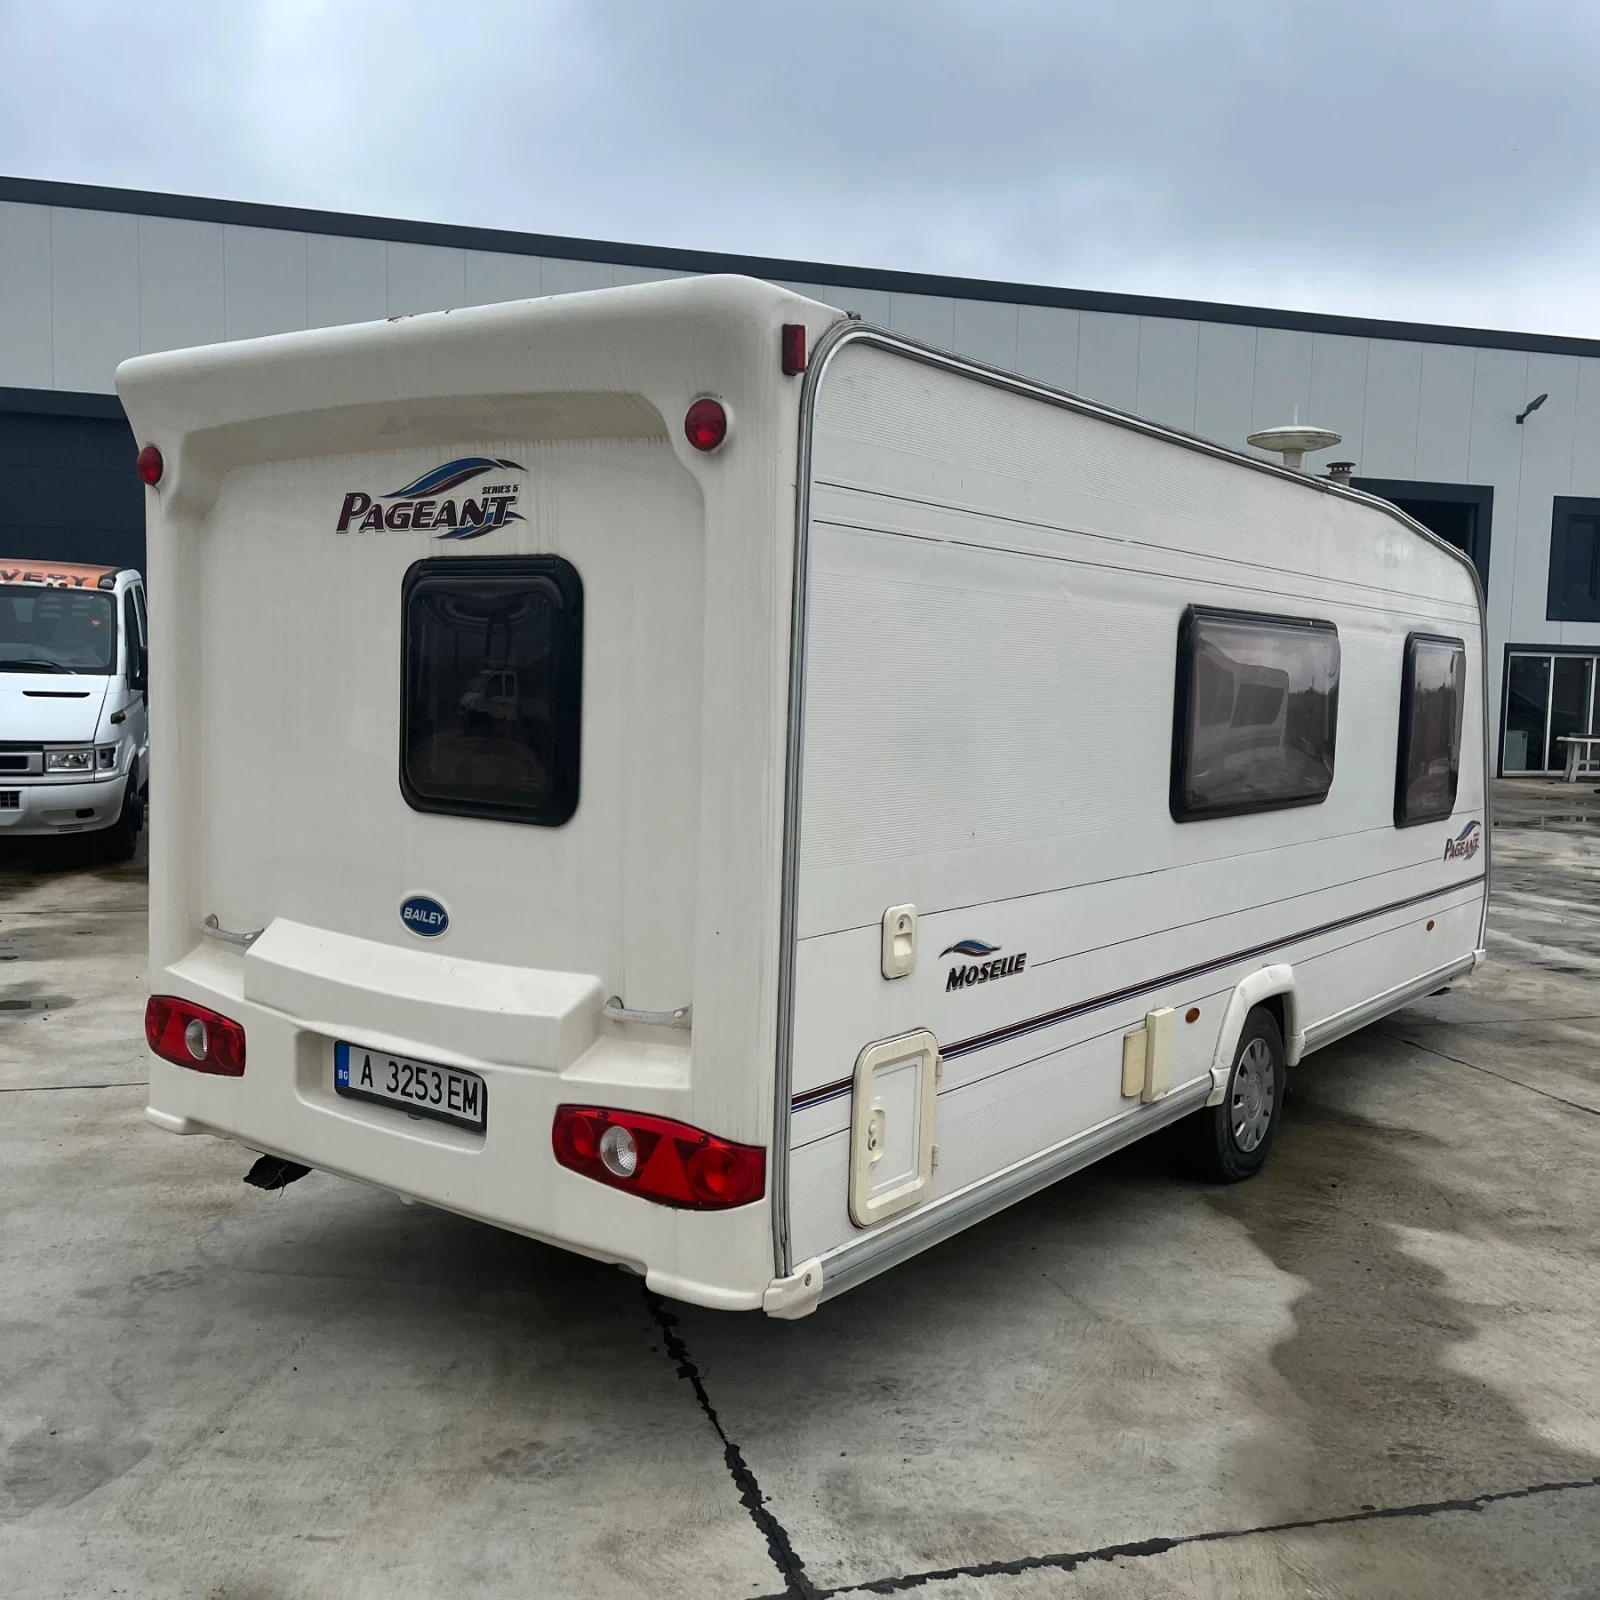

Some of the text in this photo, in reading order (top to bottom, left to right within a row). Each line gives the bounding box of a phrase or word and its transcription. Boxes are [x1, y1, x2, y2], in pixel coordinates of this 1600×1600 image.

[482, 484, 519, 495] SERIES 5
[403, 906, 445, 926] BAILEY
[338, 1069, 349, 1081] BG
[360, 1054, 374, 1088] A
